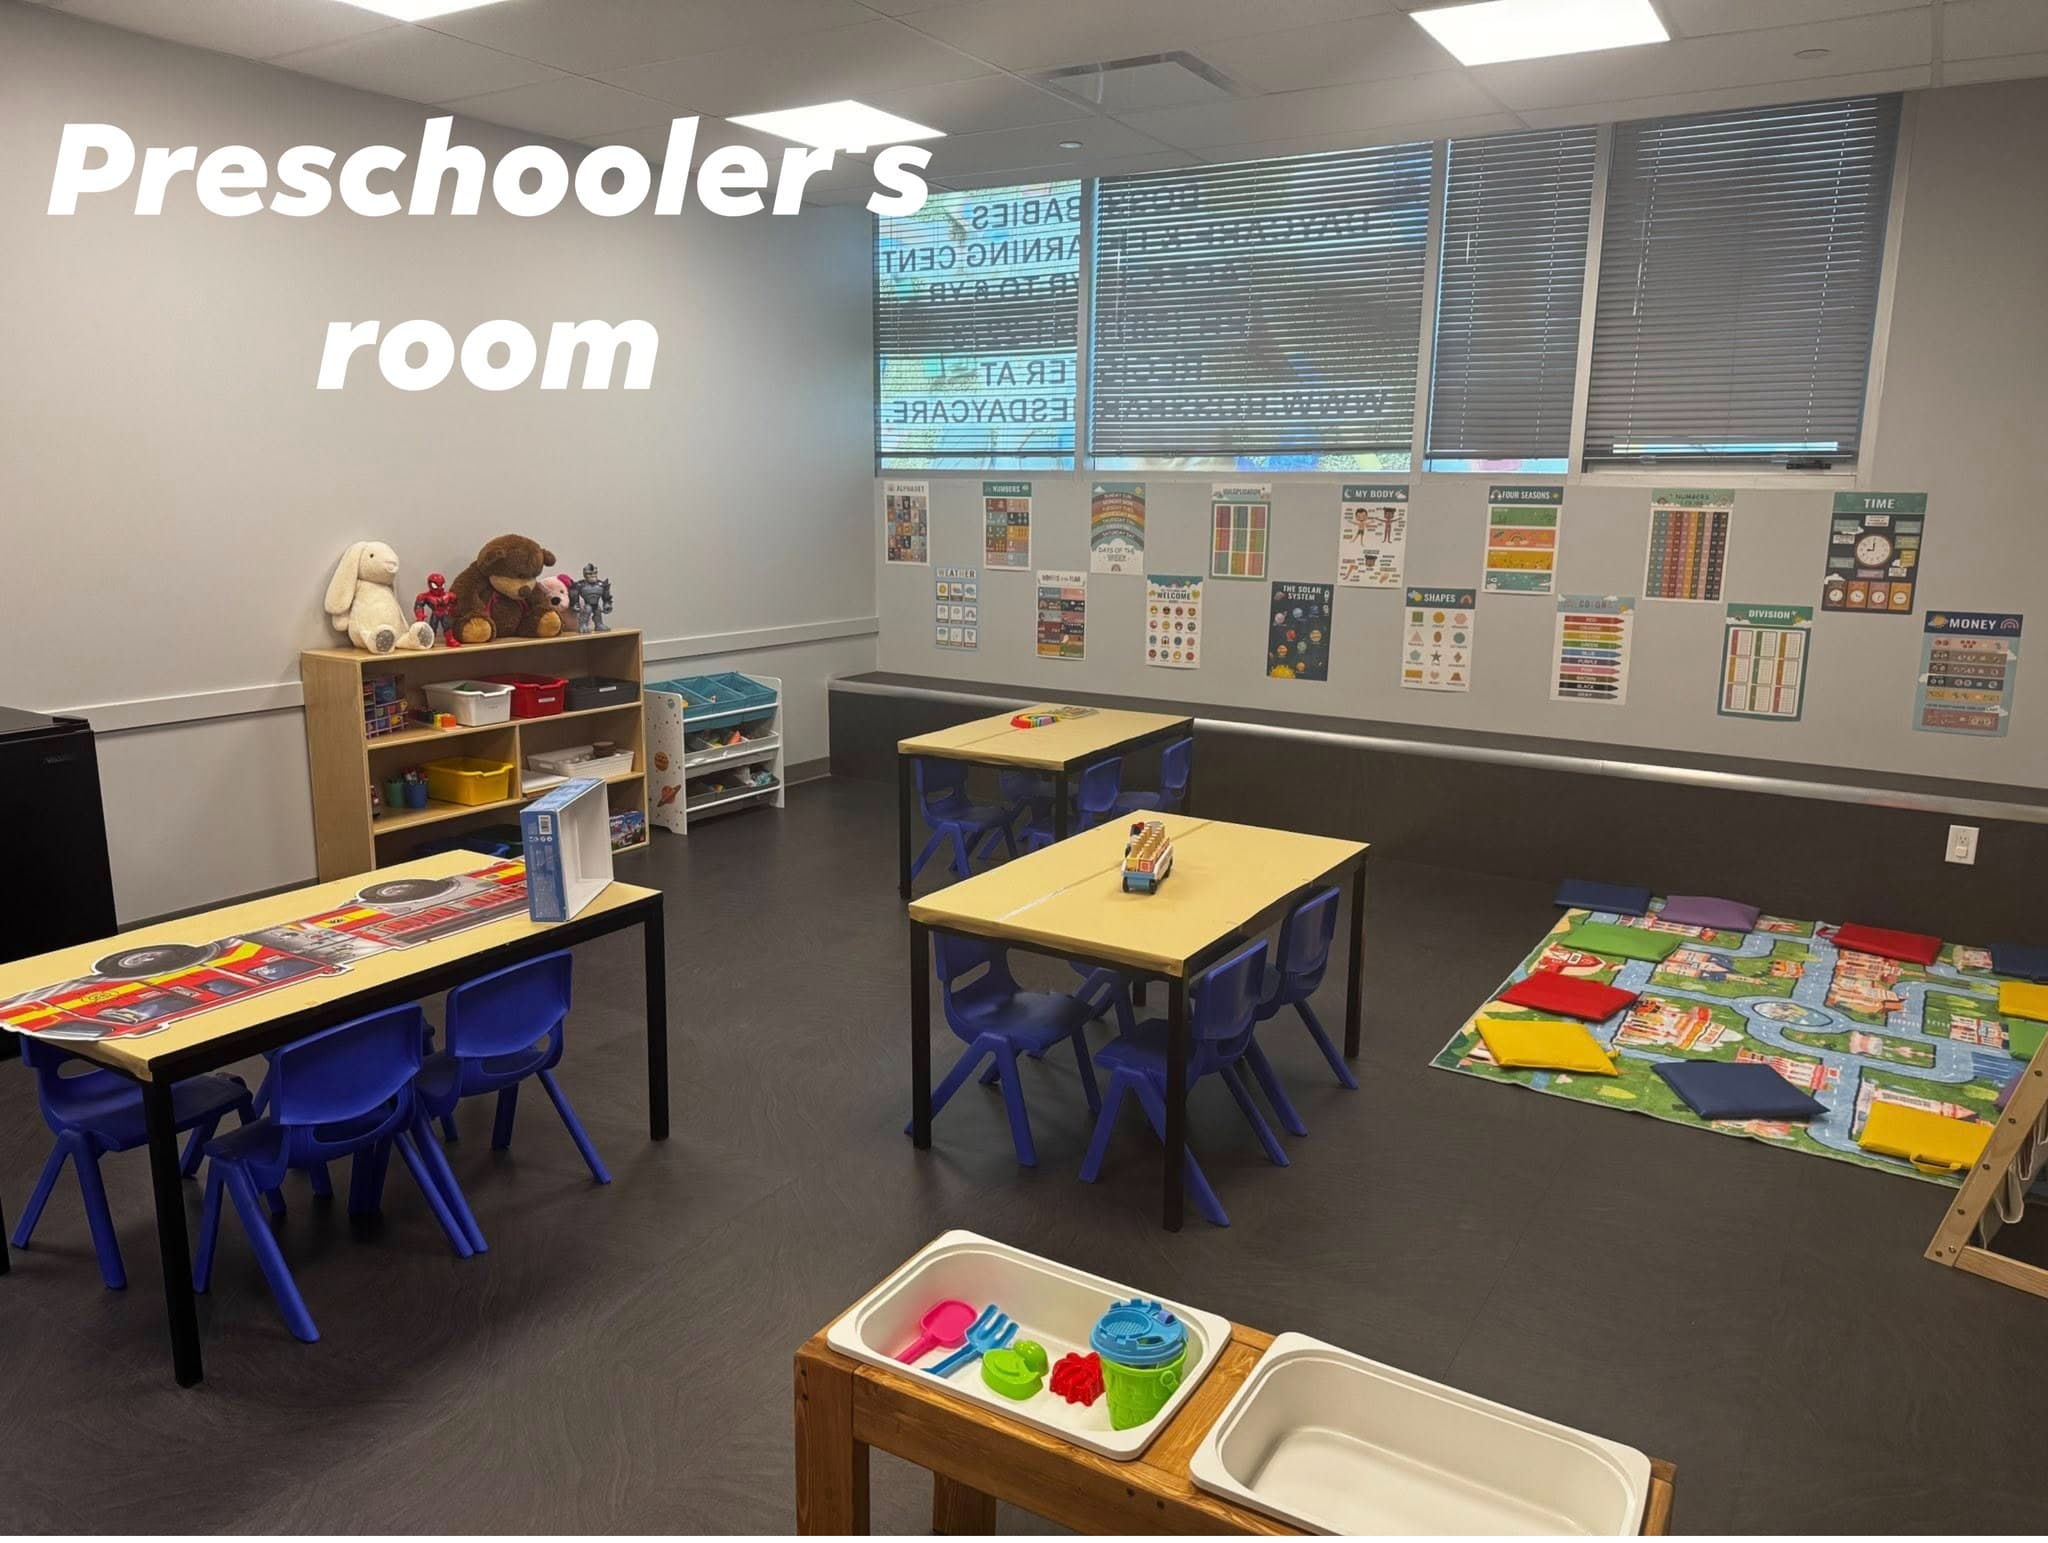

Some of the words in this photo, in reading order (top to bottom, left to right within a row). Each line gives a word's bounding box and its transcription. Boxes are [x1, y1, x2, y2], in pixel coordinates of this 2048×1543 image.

[1355, 489, 1368, 498] MY
[1370, 489, 1394, 498] BODY
[1502, 490, 1519, 499] FOUR
[1521, 491, 1550, 500] SEASONS
[1863, 498, 1896, 509] TIME
[1283, 585, 1296, 593] THE
[1298, 585, 1322, 594] SOLAR
[1157, 591, 1191, 600] WELCOME
[1287, 592, 1316, 601] SYSTEM
[1423, 593, 1457, 603] SHAPES
[1748, 609, 1791, 619] DIVISION
[1949, 618, 1997, 630] MONEY
